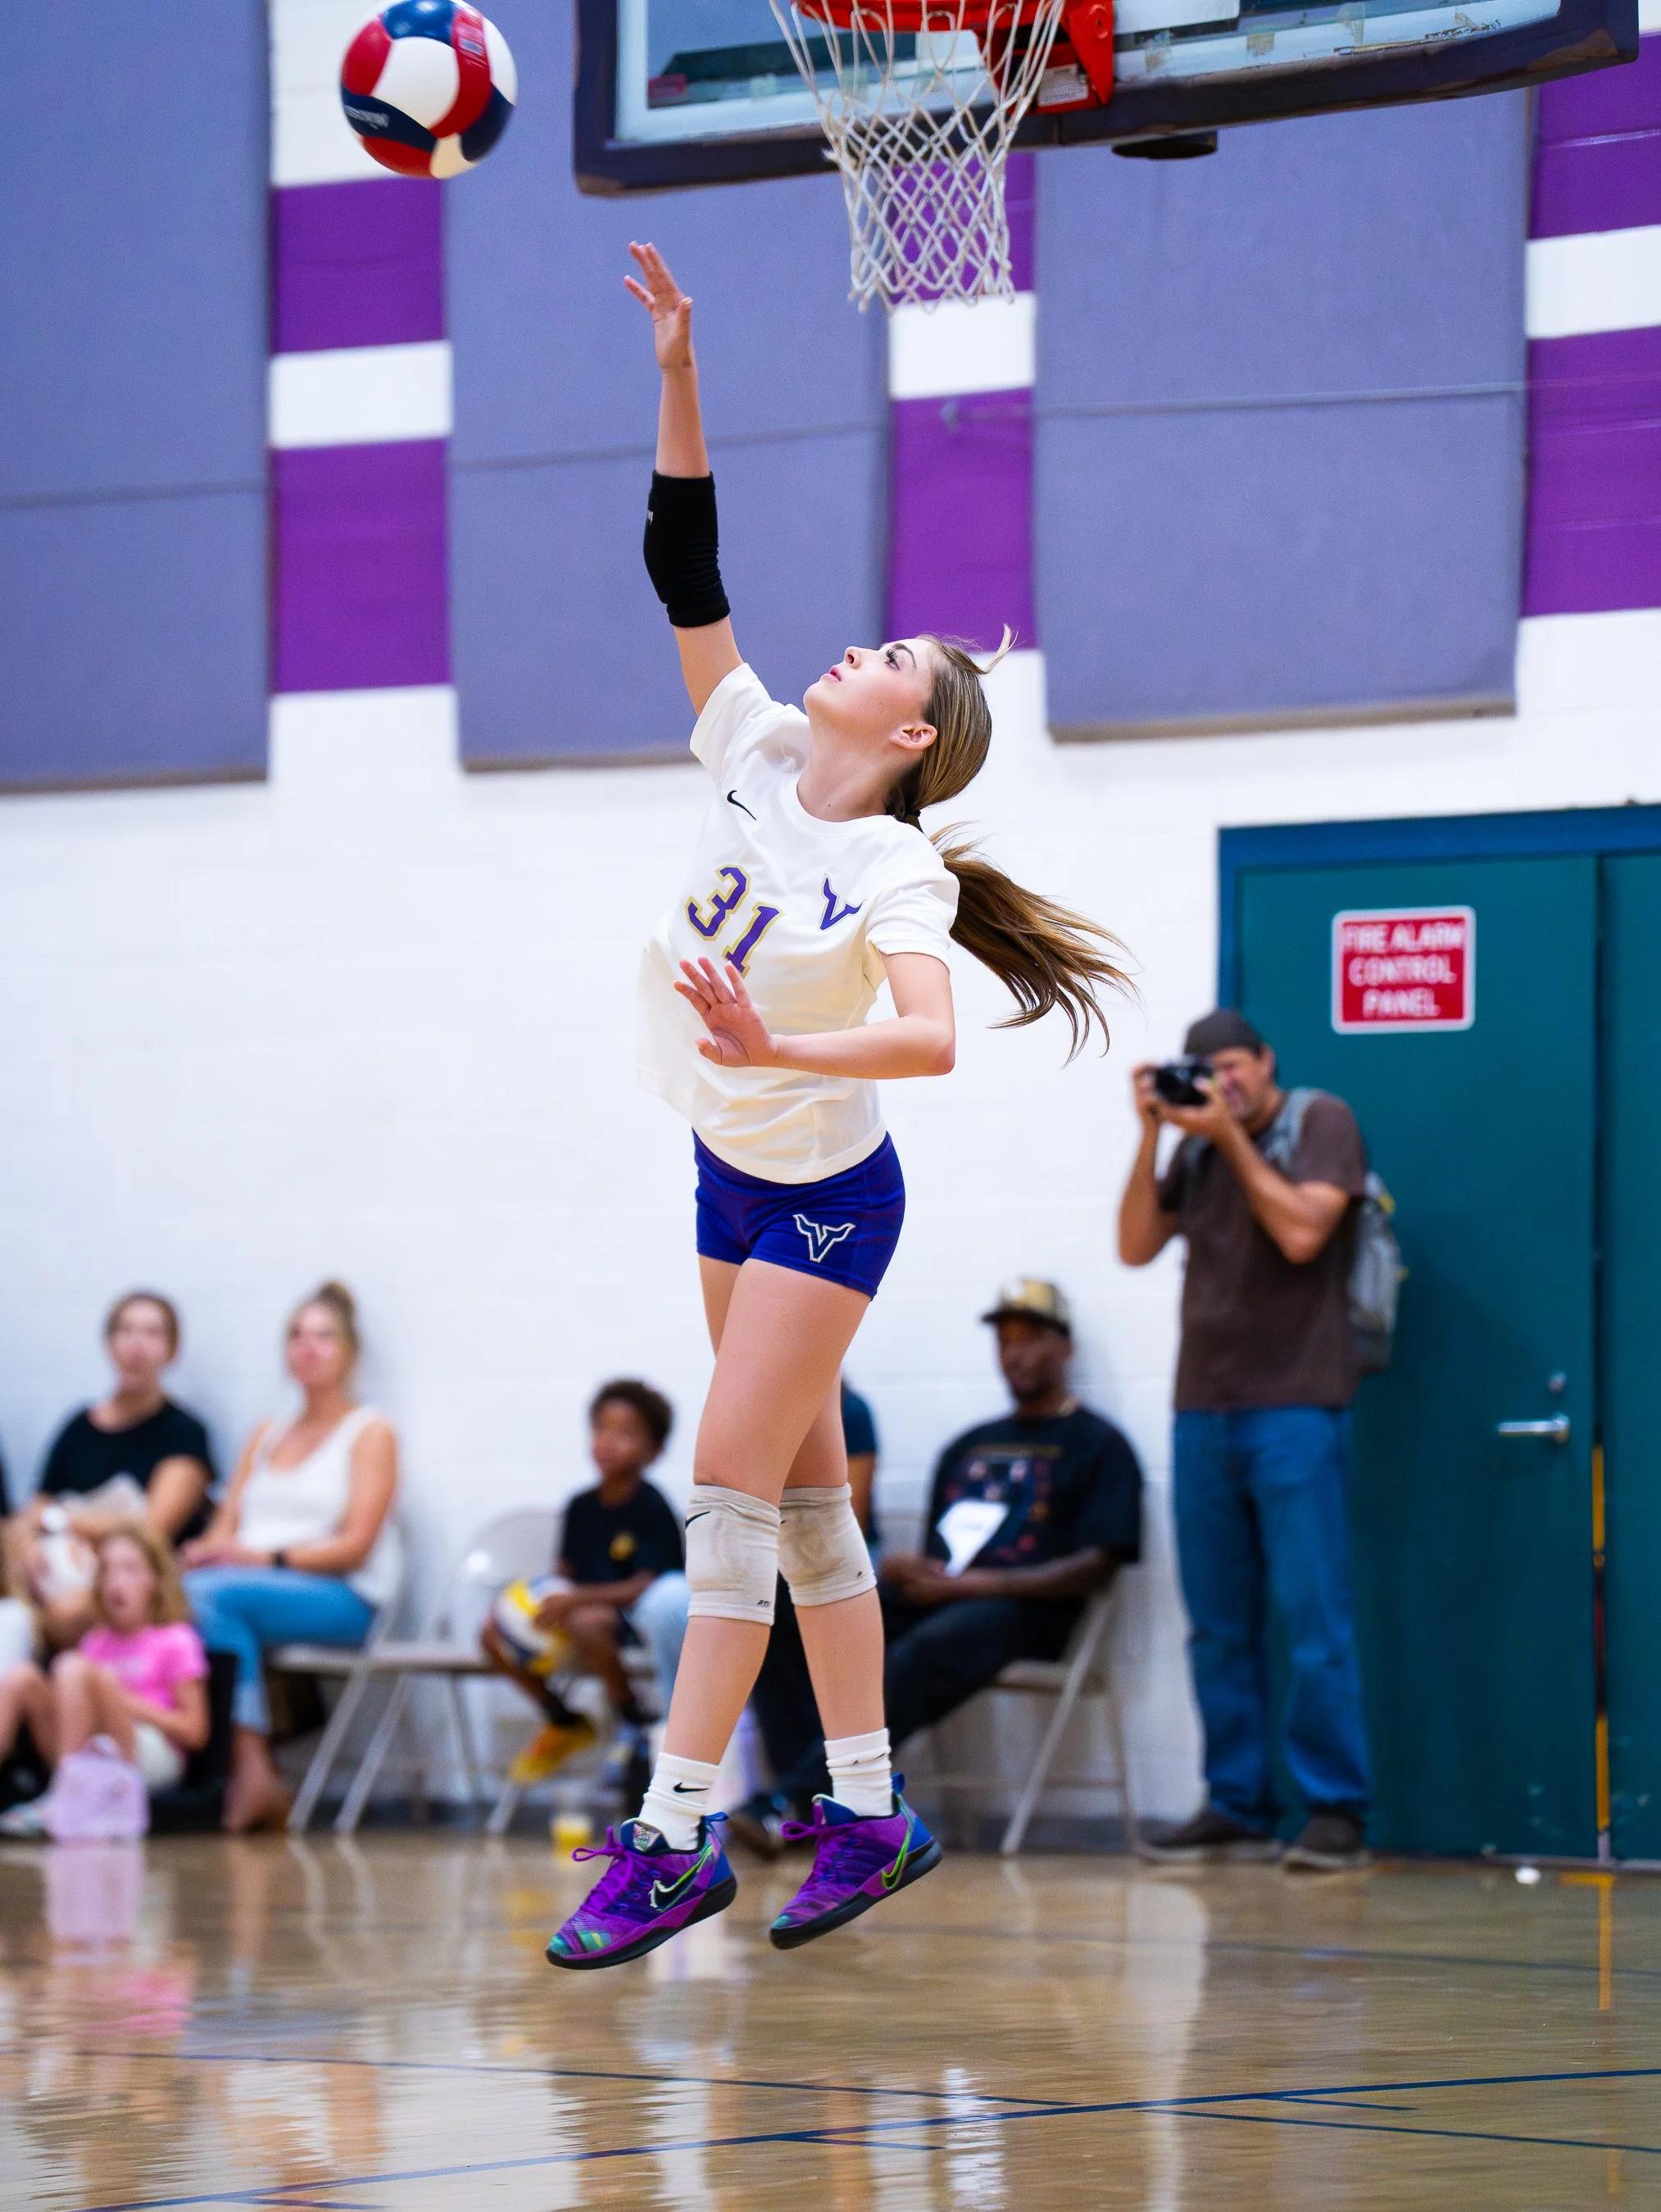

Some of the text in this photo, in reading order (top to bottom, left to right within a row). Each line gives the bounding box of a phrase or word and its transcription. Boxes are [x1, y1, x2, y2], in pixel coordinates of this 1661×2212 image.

[685, 864, 785, 979] 31
[1343, 921, 1464, 953] FIRE ALARM
[1348, 955, 1457, 986] CONTROL
[1362, 988, 1441, 1018] PANEL
